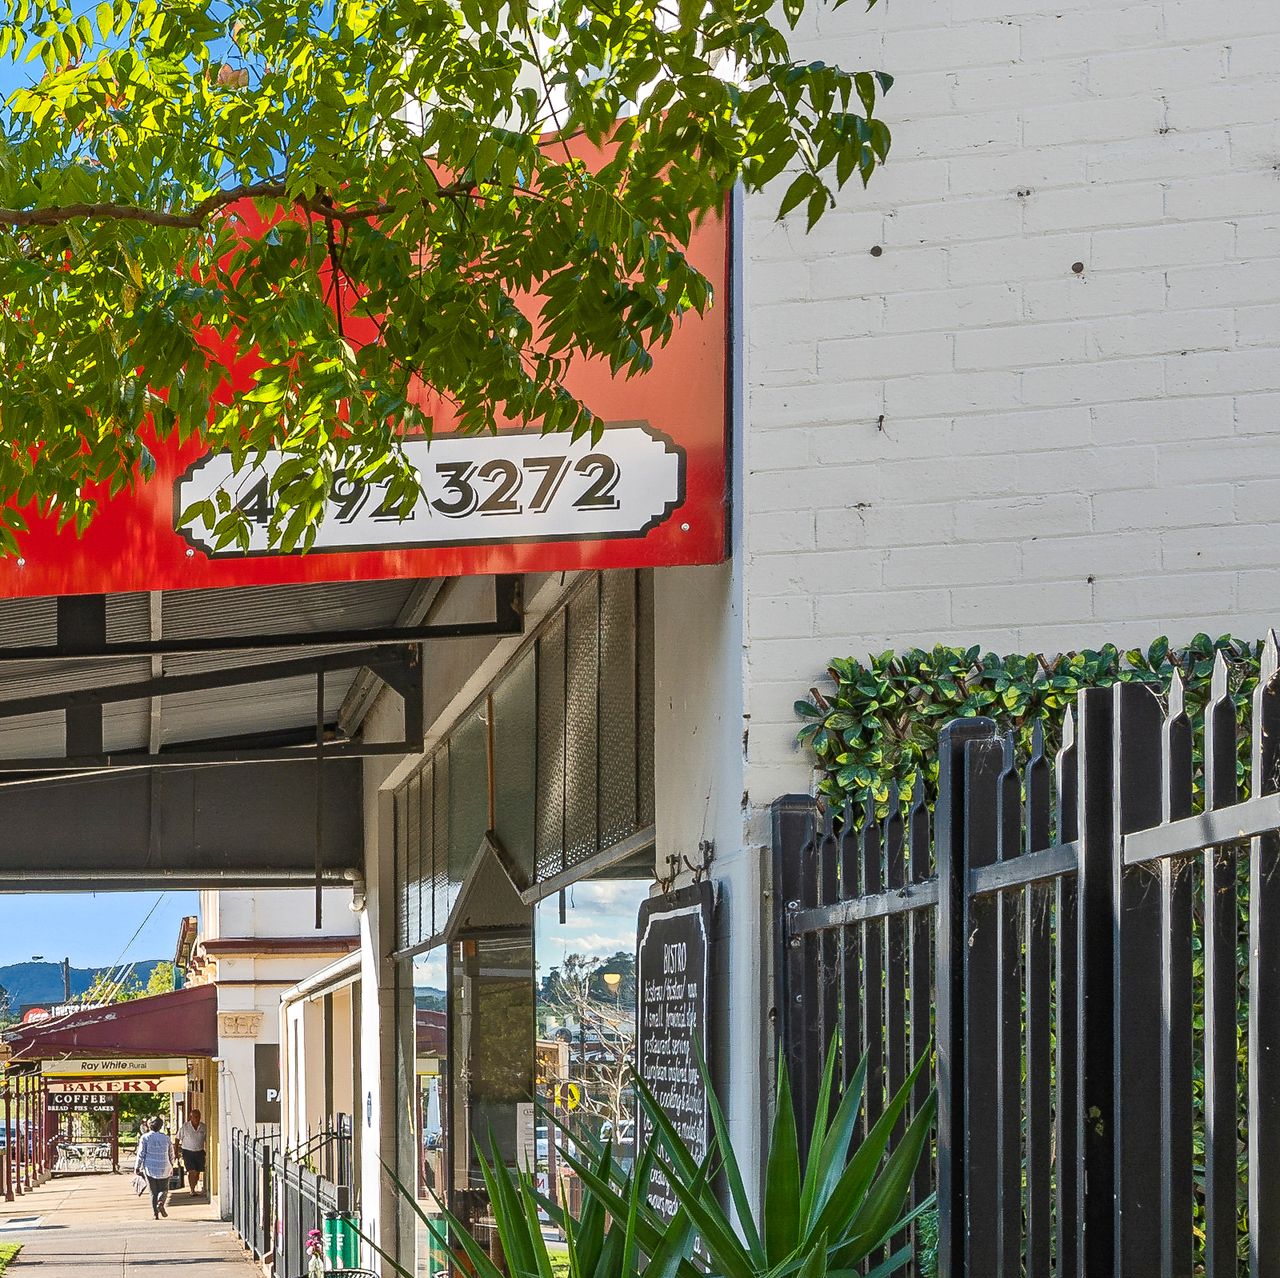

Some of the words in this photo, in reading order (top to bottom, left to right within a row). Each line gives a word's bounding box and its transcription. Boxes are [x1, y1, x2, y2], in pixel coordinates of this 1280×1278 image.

[230, 466, 415, 529] 492
[431, 453, 620, 518] 3272
[663, 942, 687, 974] BISTRO
[649, 1003, 664, 1028] small
[81, 1062, 99, 1071] Ray
[101, 1061, 128, 1070] White
[62, 1080, 166, 1092] BAKERY
[54, 1094, 106, 1104] COFFEE
